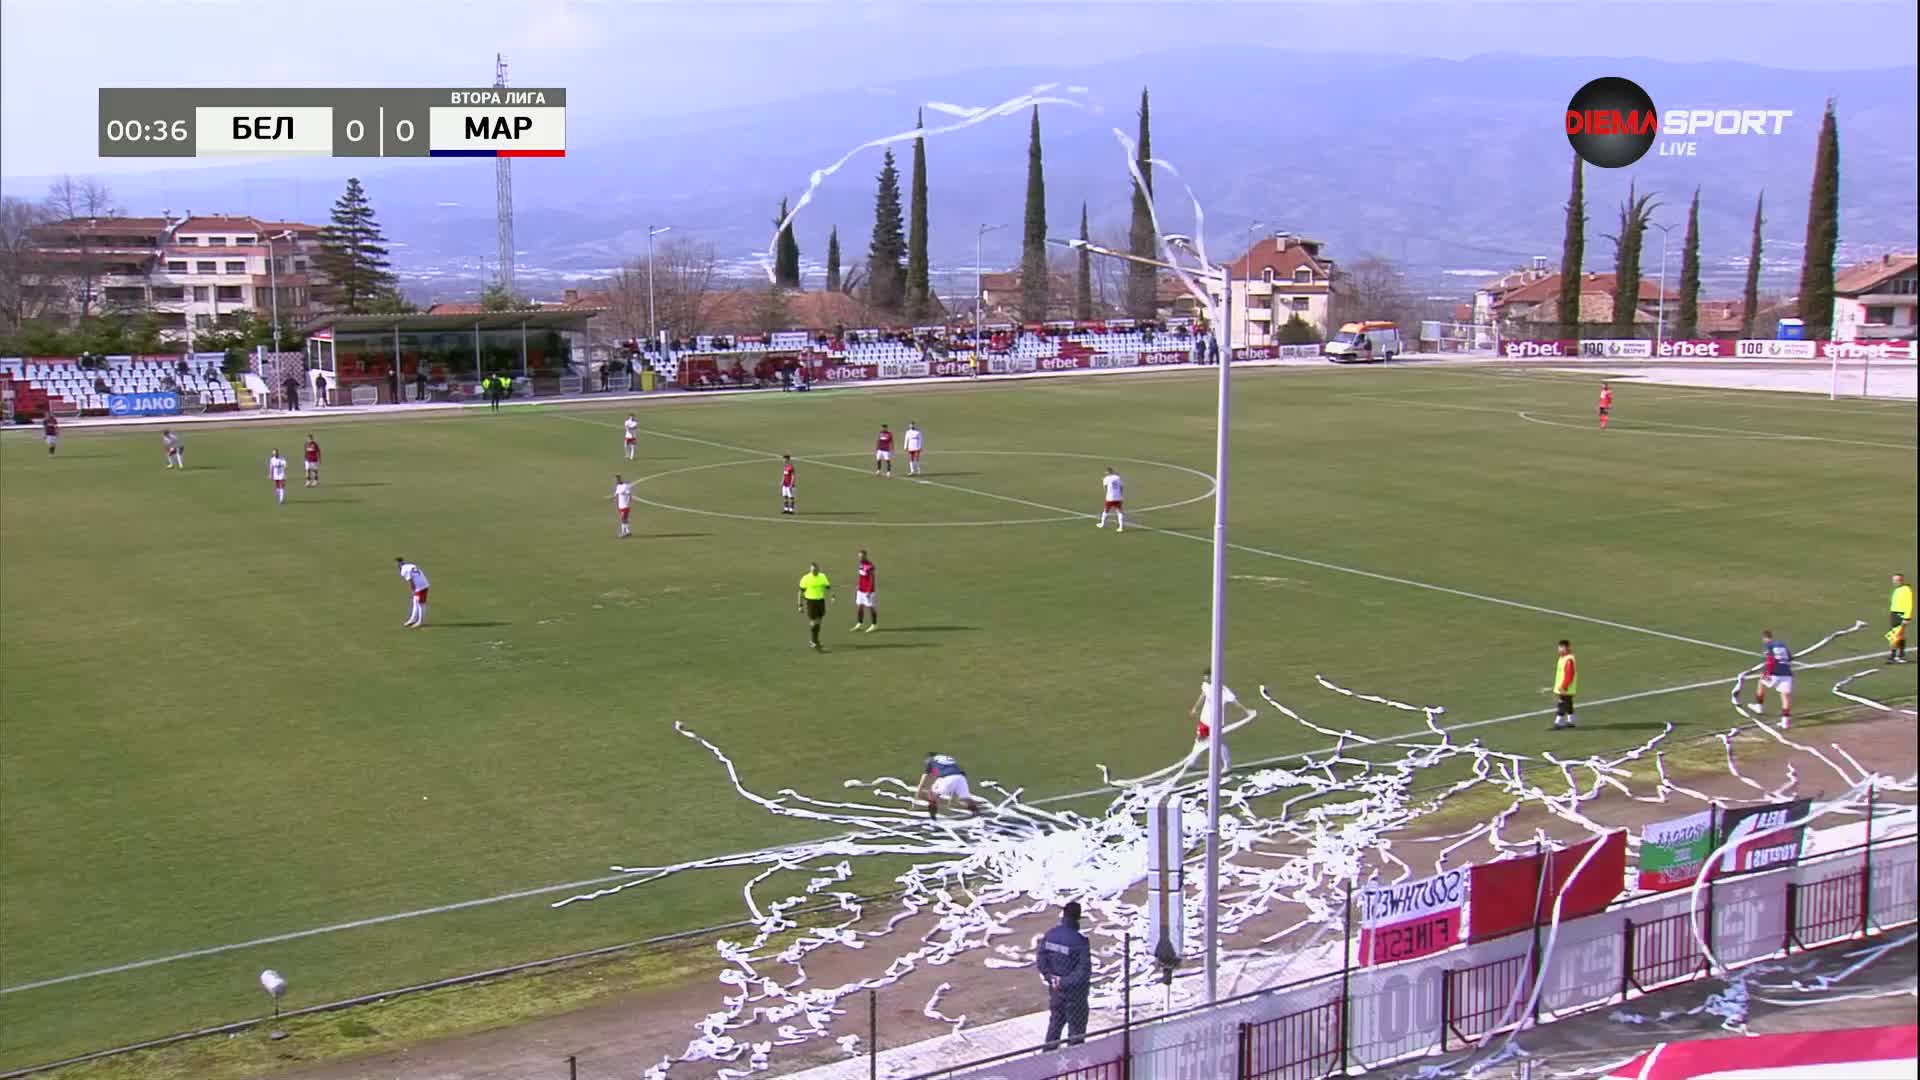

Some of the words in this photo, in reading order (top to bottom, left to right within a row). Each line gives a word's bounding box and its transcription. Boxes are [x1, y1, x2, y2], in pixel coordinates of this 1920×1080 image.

[1506, 341, 1561, 357] efbet
[1583, 342, 1604, 354] 100
[1660, 342, 1719, 357] efbet
[1741, 343, 1763, 354] 100
[1042, 357, 1079, 369] efbet
[1146, 352, 1181, 363] efbet
[826, 367, 868, 379] efbet
[936, 362, 975, 374] efbe
[133, 398, 176, 410] JAKO
